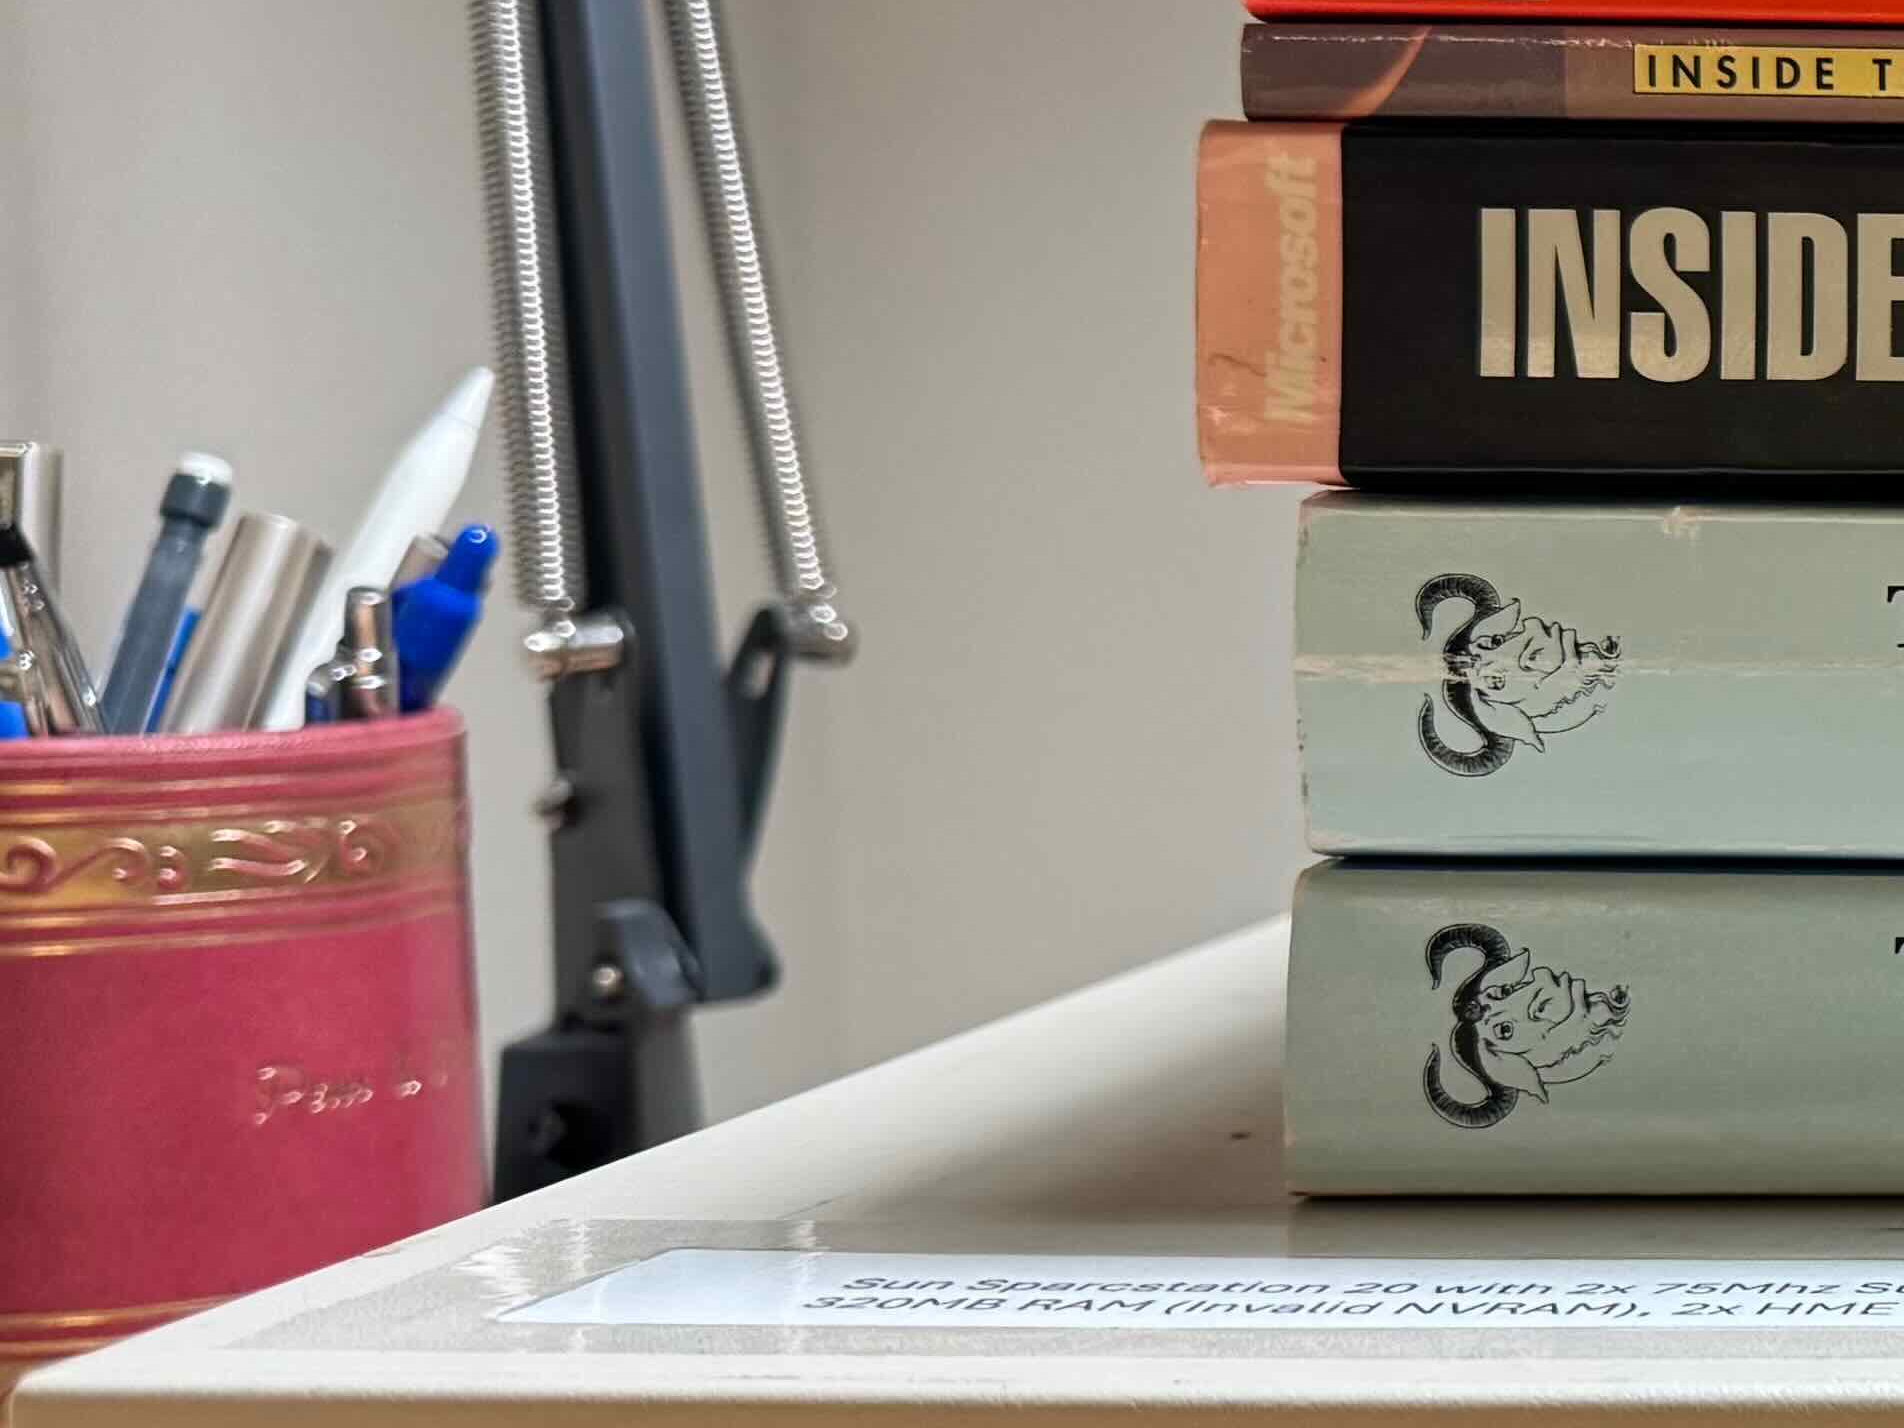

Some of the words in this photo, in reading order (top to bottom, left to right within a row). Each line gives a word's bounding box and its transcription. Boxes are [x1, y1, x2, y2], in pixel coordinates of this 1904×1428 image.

[1647, 54, 1835, 92] INSIDE
[1263, 156, 1319, 423] Microsoft
[842, 1277, 954, 1291] Sun
[964, 1278, 1330, 1294] Sparcstation
[1342, 1282, 1418, 1294] 20
[1434, 1281, 1555, 1295] with
[1565, 1283, 1636, 1295] 2x
[1651, 1282, 1838, 1295] 75Mhz
[801, 1296, 1009, 1311] 320MB
[1017, 1298, 1153, 1312] RAM
[1163, 1299, 1385, 1316] (Invalid
[1391, 1301, 1654, 1319] NVRAM),
[1670, 1302, 1745, 1316] 2x
[1753, 1302, 1902, 1316] HME
